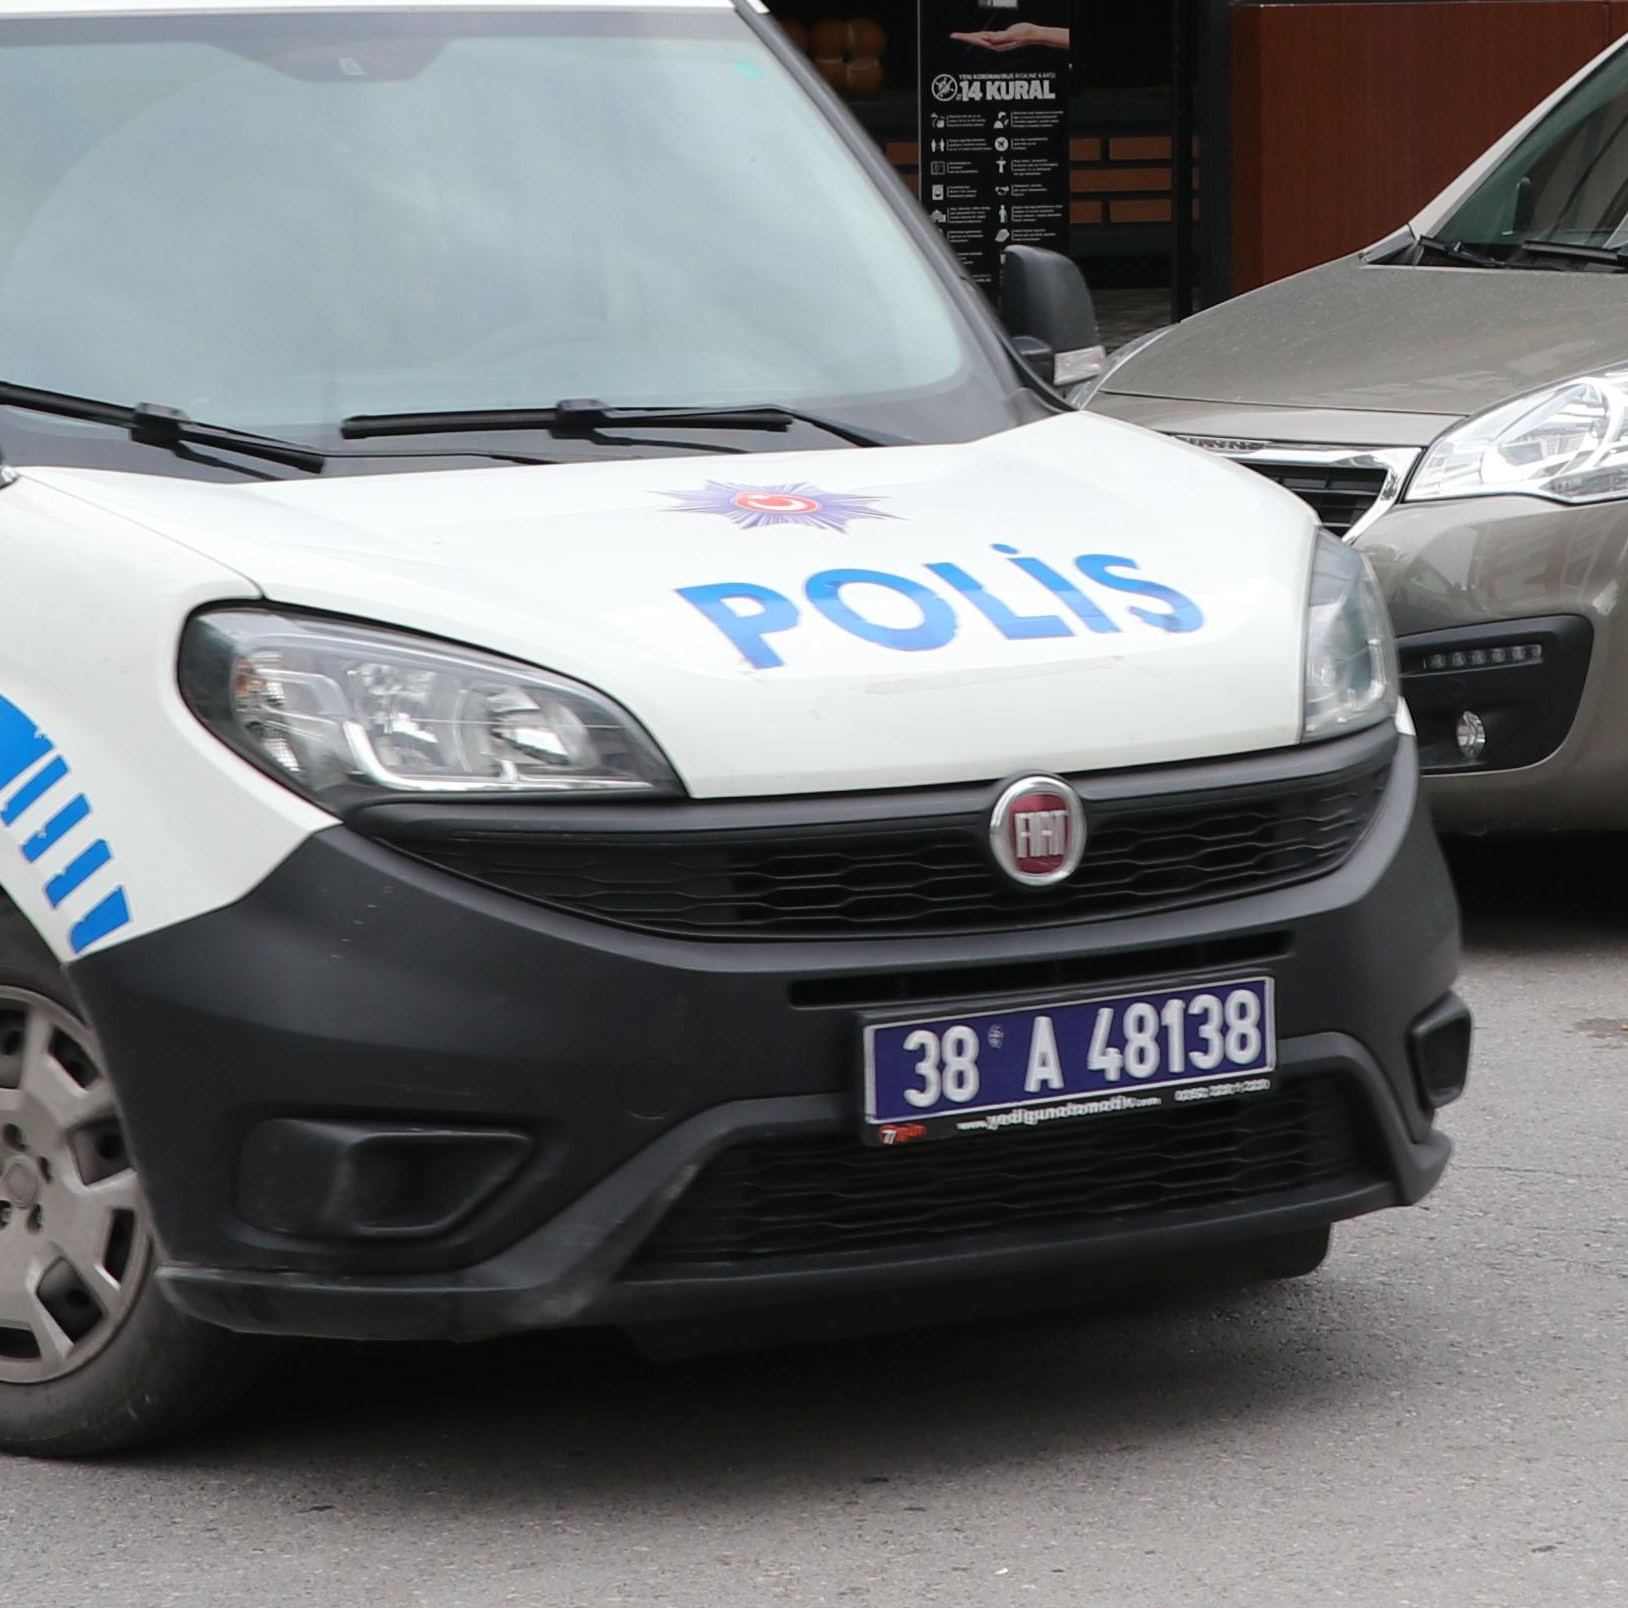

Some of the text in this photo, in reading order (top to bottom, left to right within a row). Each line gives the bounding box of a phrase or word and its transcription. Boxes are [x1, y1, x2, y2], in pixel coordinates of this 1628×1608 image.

[985, 79, 1056, 100] KURAL
[675, 544, 1205, 669] POLİS
[1014, 809, 1069, 858] FIAT
[902, 989, 1262, 1108] 38 A 48138
